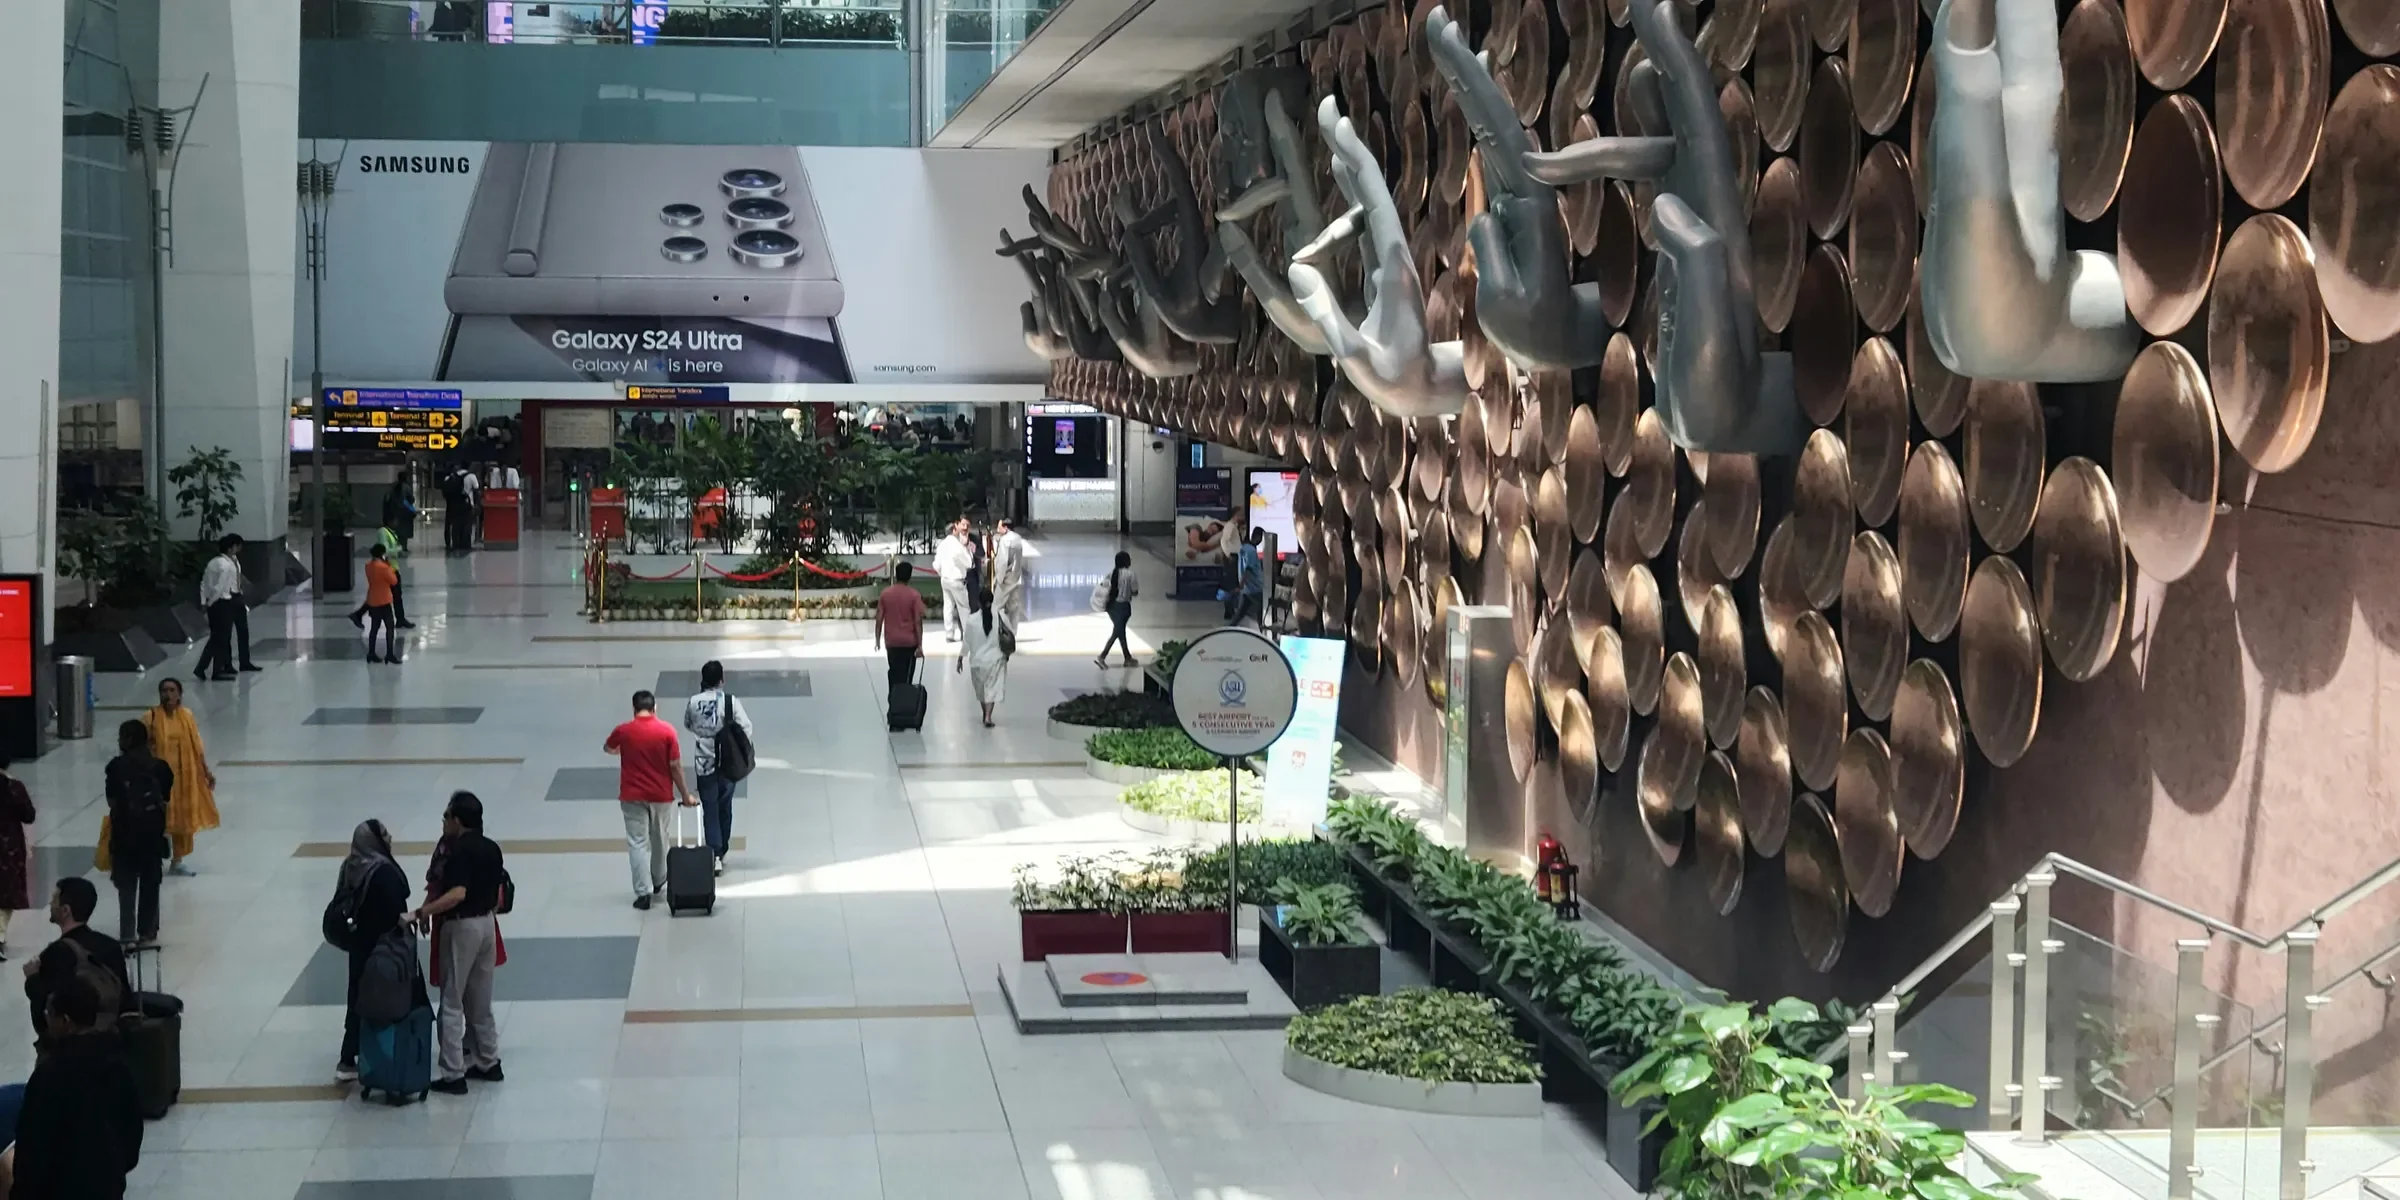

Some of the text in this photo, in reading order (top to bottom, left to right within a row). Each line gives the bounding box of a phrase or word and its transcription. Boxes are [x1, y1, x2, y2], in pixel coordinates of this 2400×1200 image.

[360, 155, 470, 174] SAMSUNG
[552, 329, 743, 355] Galaxy S24 Ultra
[572, 358, 724, 375] Galaxy AI is here
[873, 364, 937, 375] samsung.com
[360, 391, 405, 399] International
[441, 392, 460, 400] Desk
[390, 411, 420, 420] Terminal
[380, 433, 393, 441] Exit
